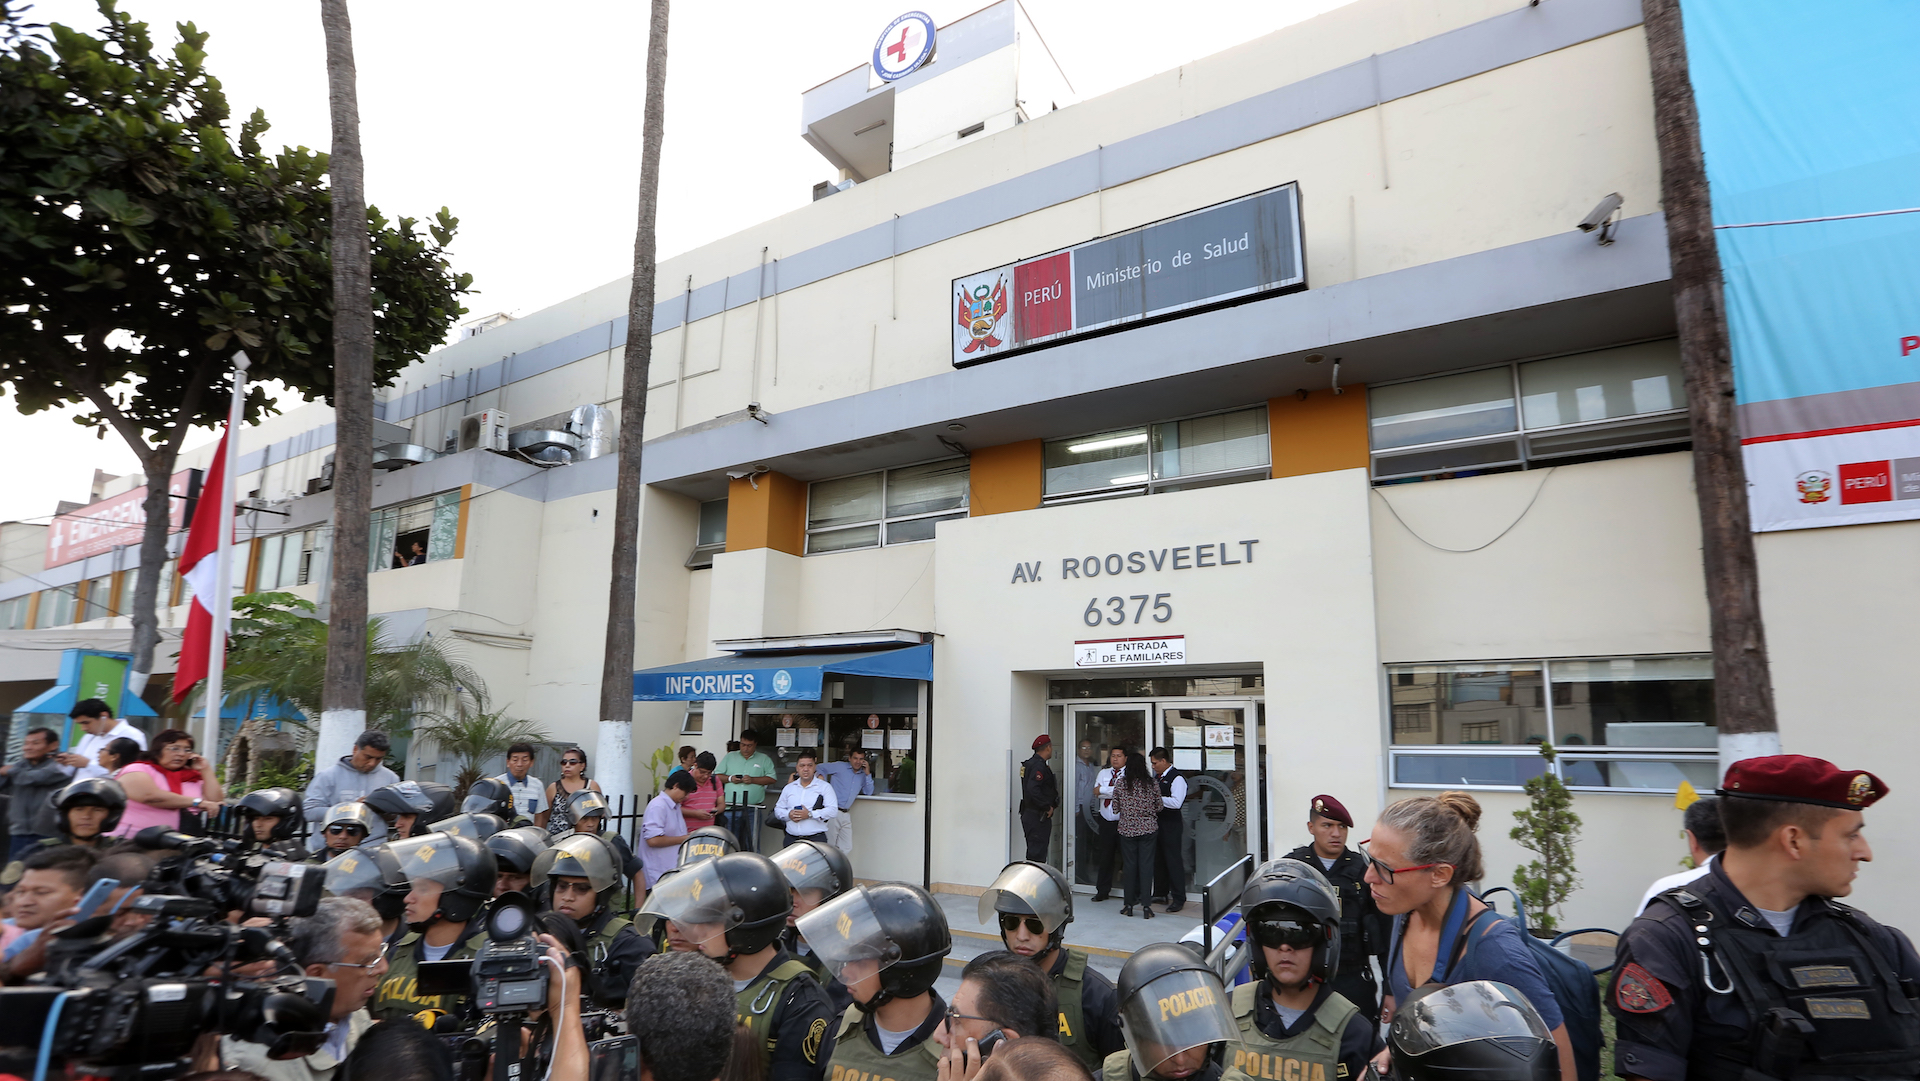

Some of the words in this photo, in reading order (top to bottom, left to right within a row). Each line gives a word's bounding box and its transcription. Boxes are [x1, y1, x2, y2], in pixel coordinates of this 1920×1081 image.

[1086, 258, 1162, 290] Ministerio
[1171, 250, 1192, 268] de
[1203, 232, 1249, 260] Salud
[1024, 279, 1062, 307] PERÚ
[1844, 473, 1888, 490] PERÚ
[1011, 561, 1042, 584] AV.
[1062, 539, 1260, 580] ROOSVEELT
[1084, 593, 1172, 627] 6375
[1102, 655, 1116, 663] DE
[1120, 652, 1184, 662] FAMILIARES
[1116, 641, 1168, 651] ENTRADA
[665, 674, 755, 695] INFORMES
[688, 843, 725, 858] POLICIA
[1158, 985, 1217, 1022] POLICIA
[1234, 1050, 1326, 1081] POLICIA
